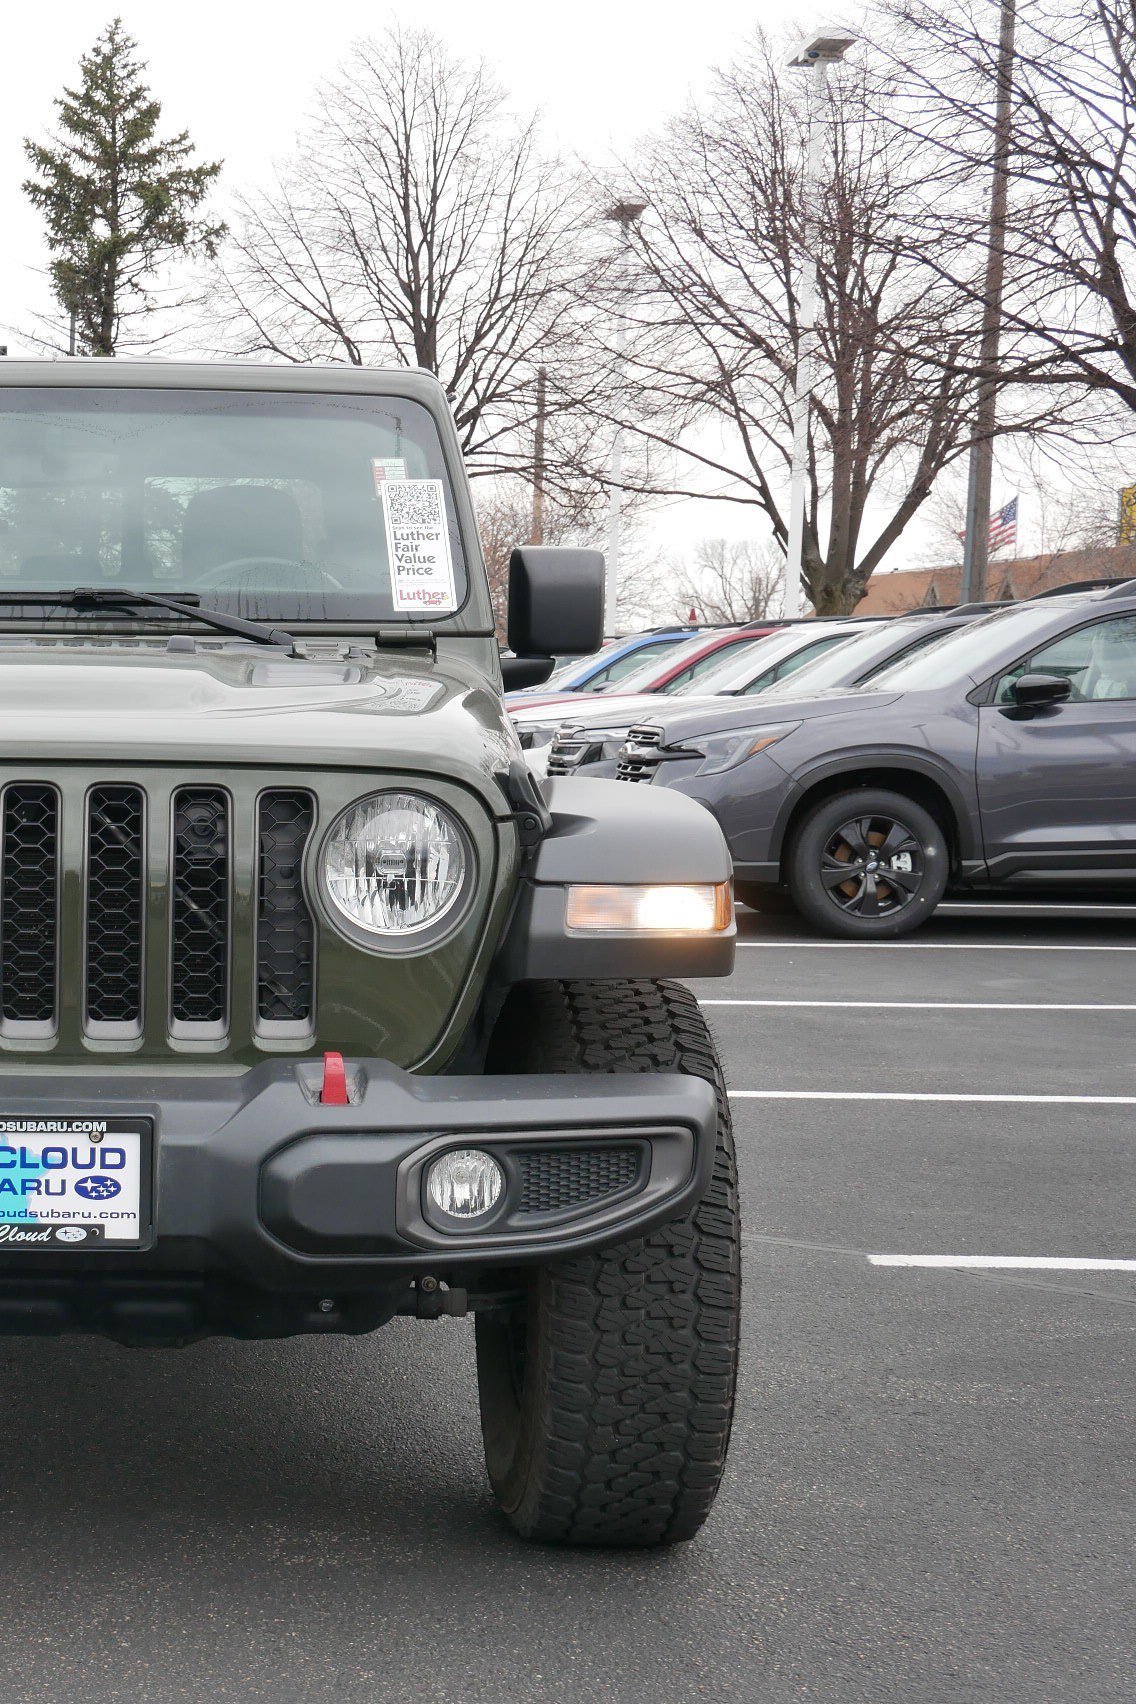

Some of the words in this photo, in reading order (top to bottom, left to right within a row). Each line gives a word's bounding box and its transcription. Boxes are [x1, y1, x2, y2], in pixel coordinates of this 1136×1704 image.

[393, 530, 441, 541] Luther
[394, 542, 421, 553] Fair
[394, 553, 436, 564] Value
[397, 565, 434, 576] Price
[399, 589, 447, 601] Luther
